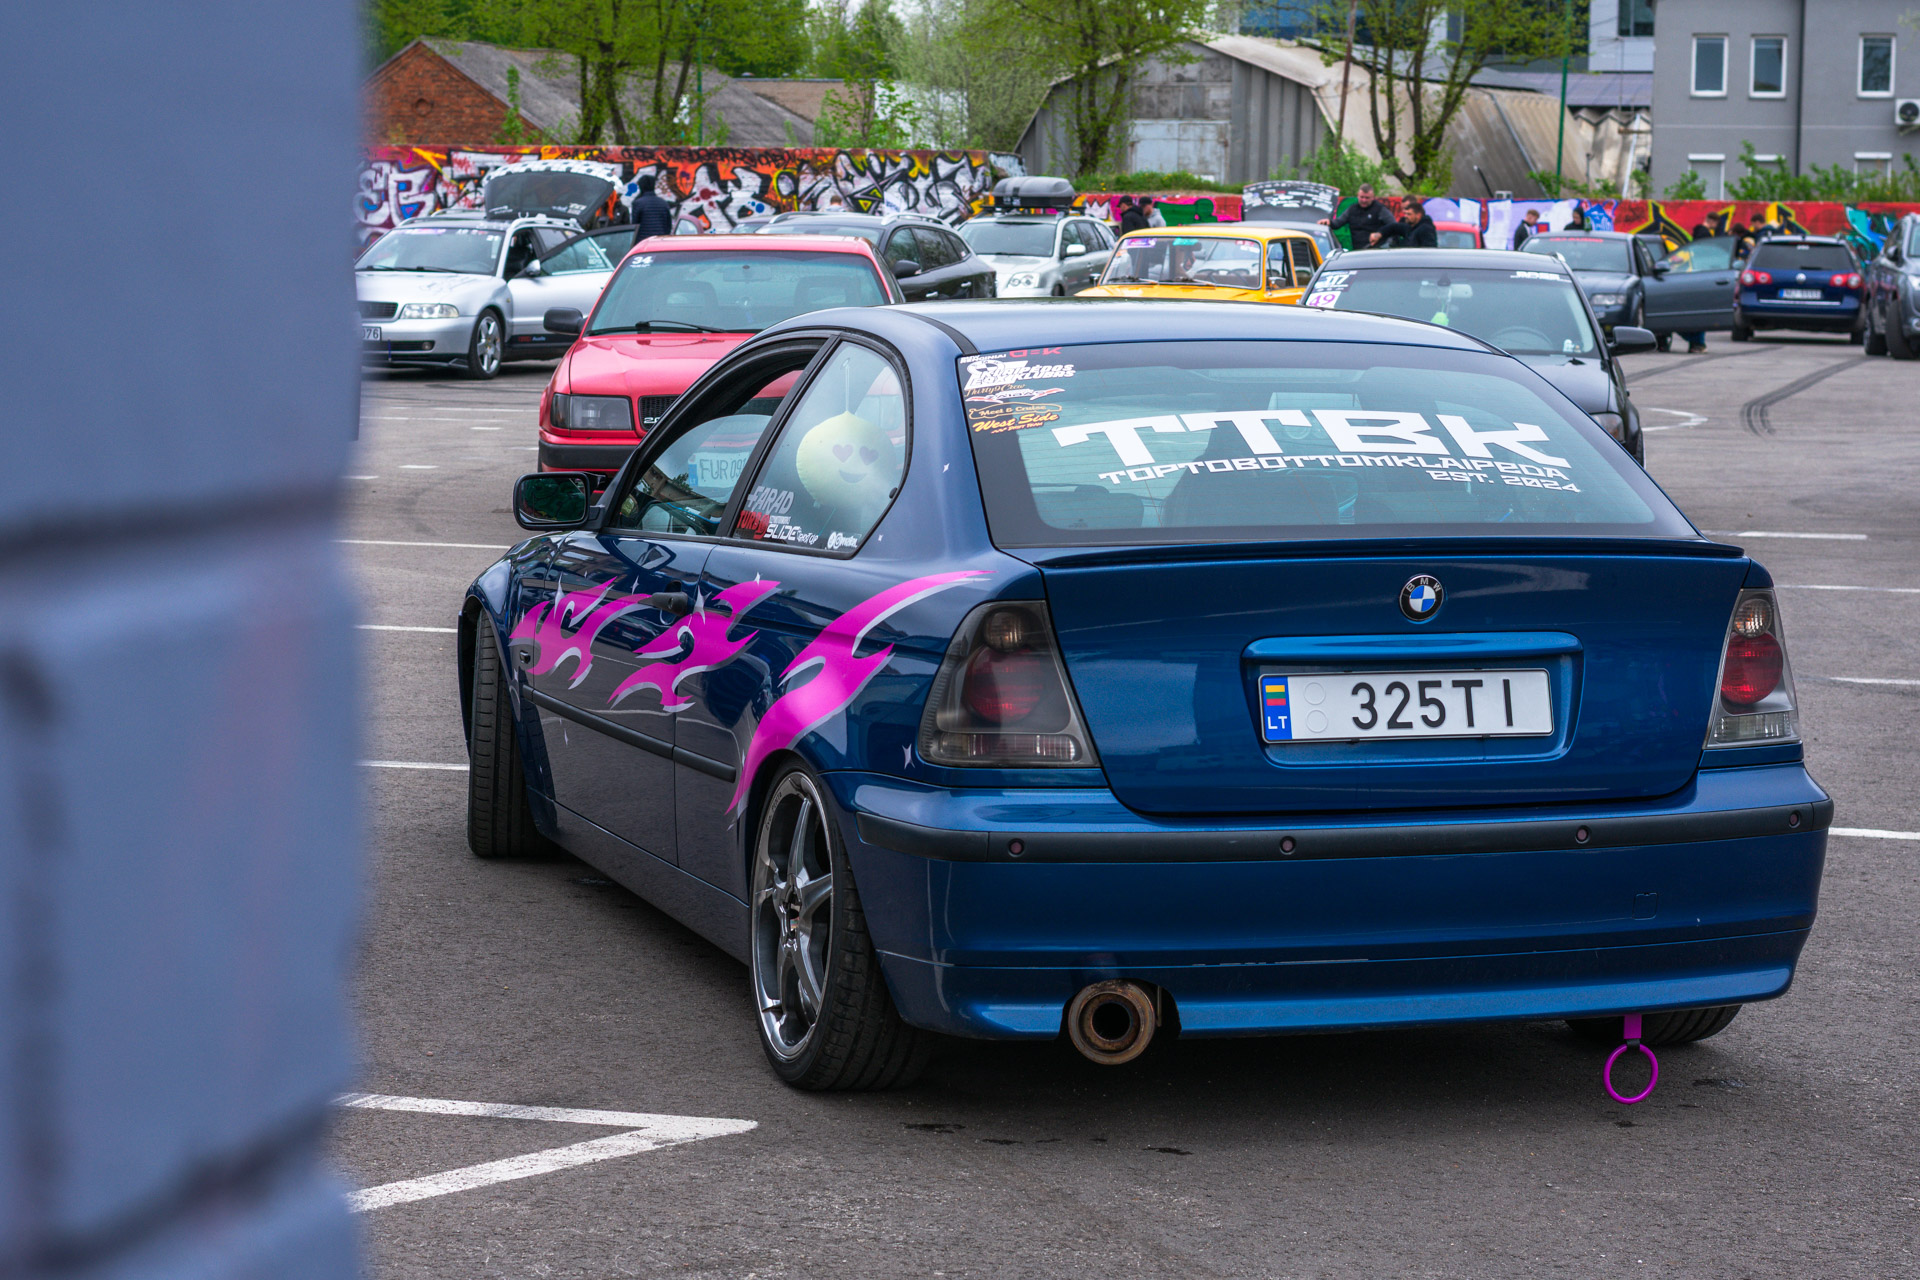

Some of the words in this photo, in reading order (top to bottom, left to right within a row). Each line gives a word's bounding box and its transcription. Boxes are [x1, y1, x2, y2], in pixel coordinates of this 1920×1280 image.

[631, 255, 654, 265] 34
[1309, 293, 1336, 307] 49
[973, 418, 1017, 432] West
[1018, 412, 1060, 425] Side
[1051, 409, 1572, 469] TTBK
[699, 459, 728, 480] FUR
[1426, 470, 1495, 486] EST.
[1504, 475, 1582, 494] 2024
[764, 523, 801, 541] SLIDE
[1405, 577, 1441, 593] BMW
[1267, 715, 1288, 730] LT
